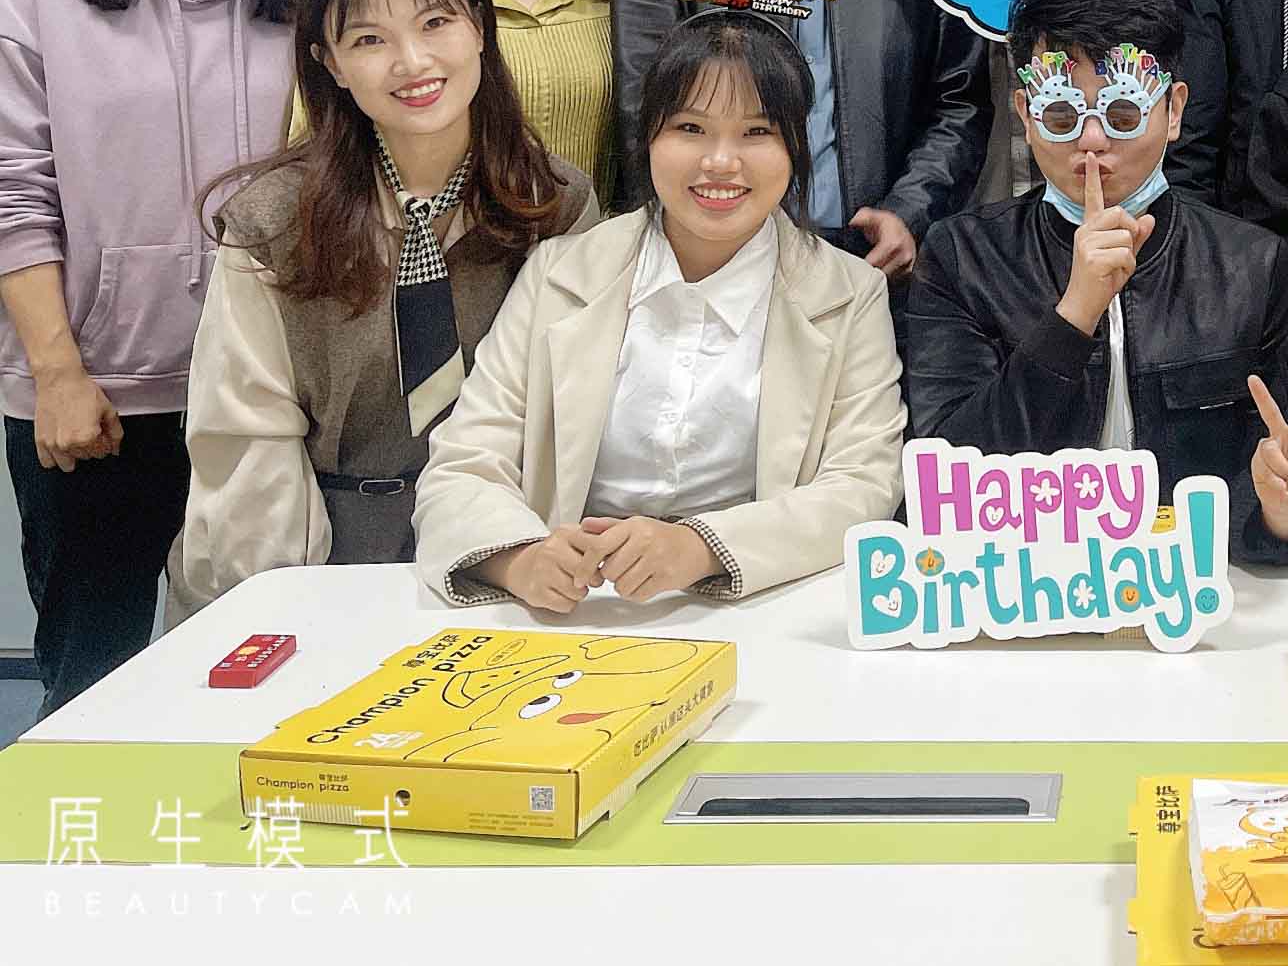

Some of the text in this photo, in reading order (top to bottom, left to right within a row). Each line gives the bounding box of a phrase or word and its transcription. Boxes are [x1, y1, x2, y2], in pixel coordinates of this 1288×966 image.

[916, 453, 1144, 543] Happy
[858, 491, 1220, 639] Birthday!
[307, 677, 437, 744] Champion
[432, 635, 493, 673] pizza
[256, 776, 349, 792] Champion pizza
